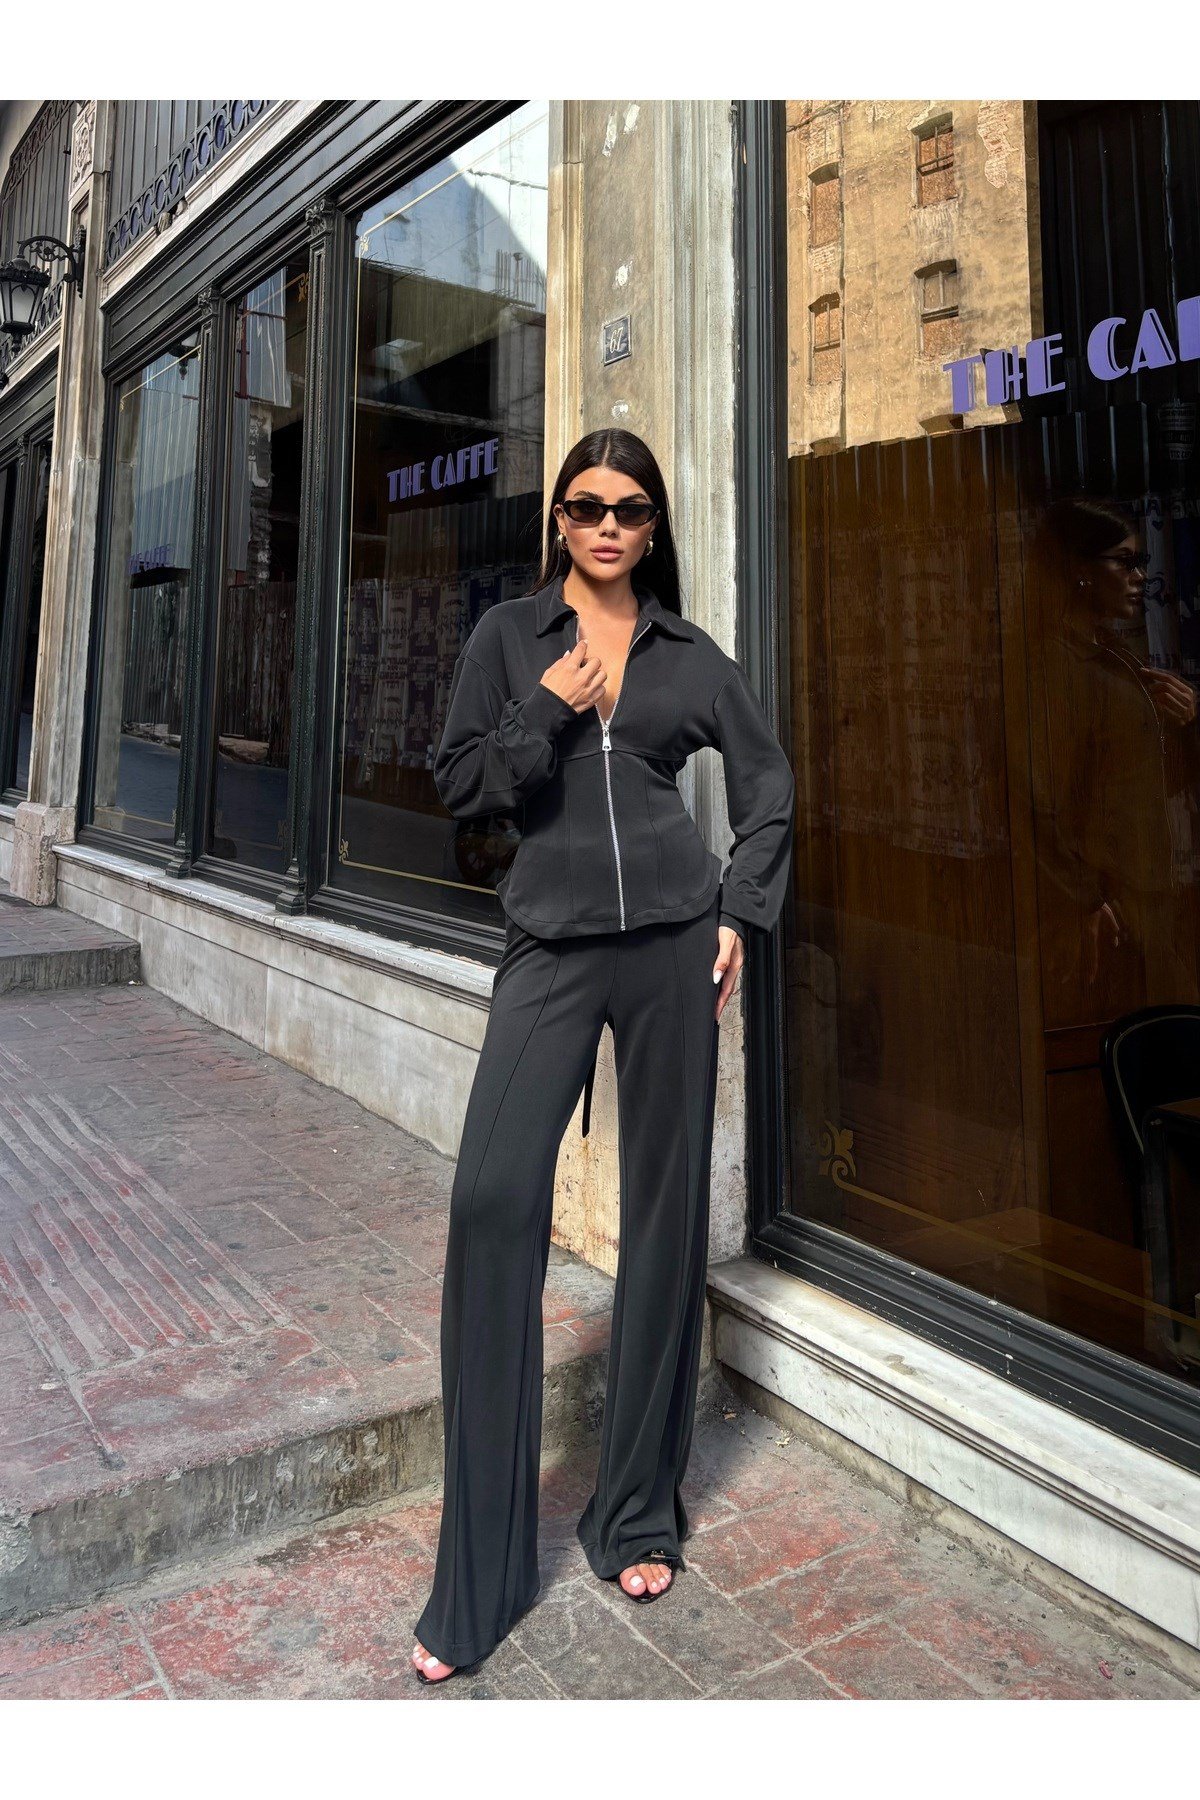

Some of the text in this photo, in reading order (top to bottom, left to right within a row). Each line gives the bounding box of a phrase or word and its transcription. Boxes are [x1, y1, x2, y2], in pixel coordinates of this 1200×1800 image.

[610, 326, 624, 354] 67
[942, 333, 1066, 415] THE
[387, 438, 499, 503] THE CAFFE
